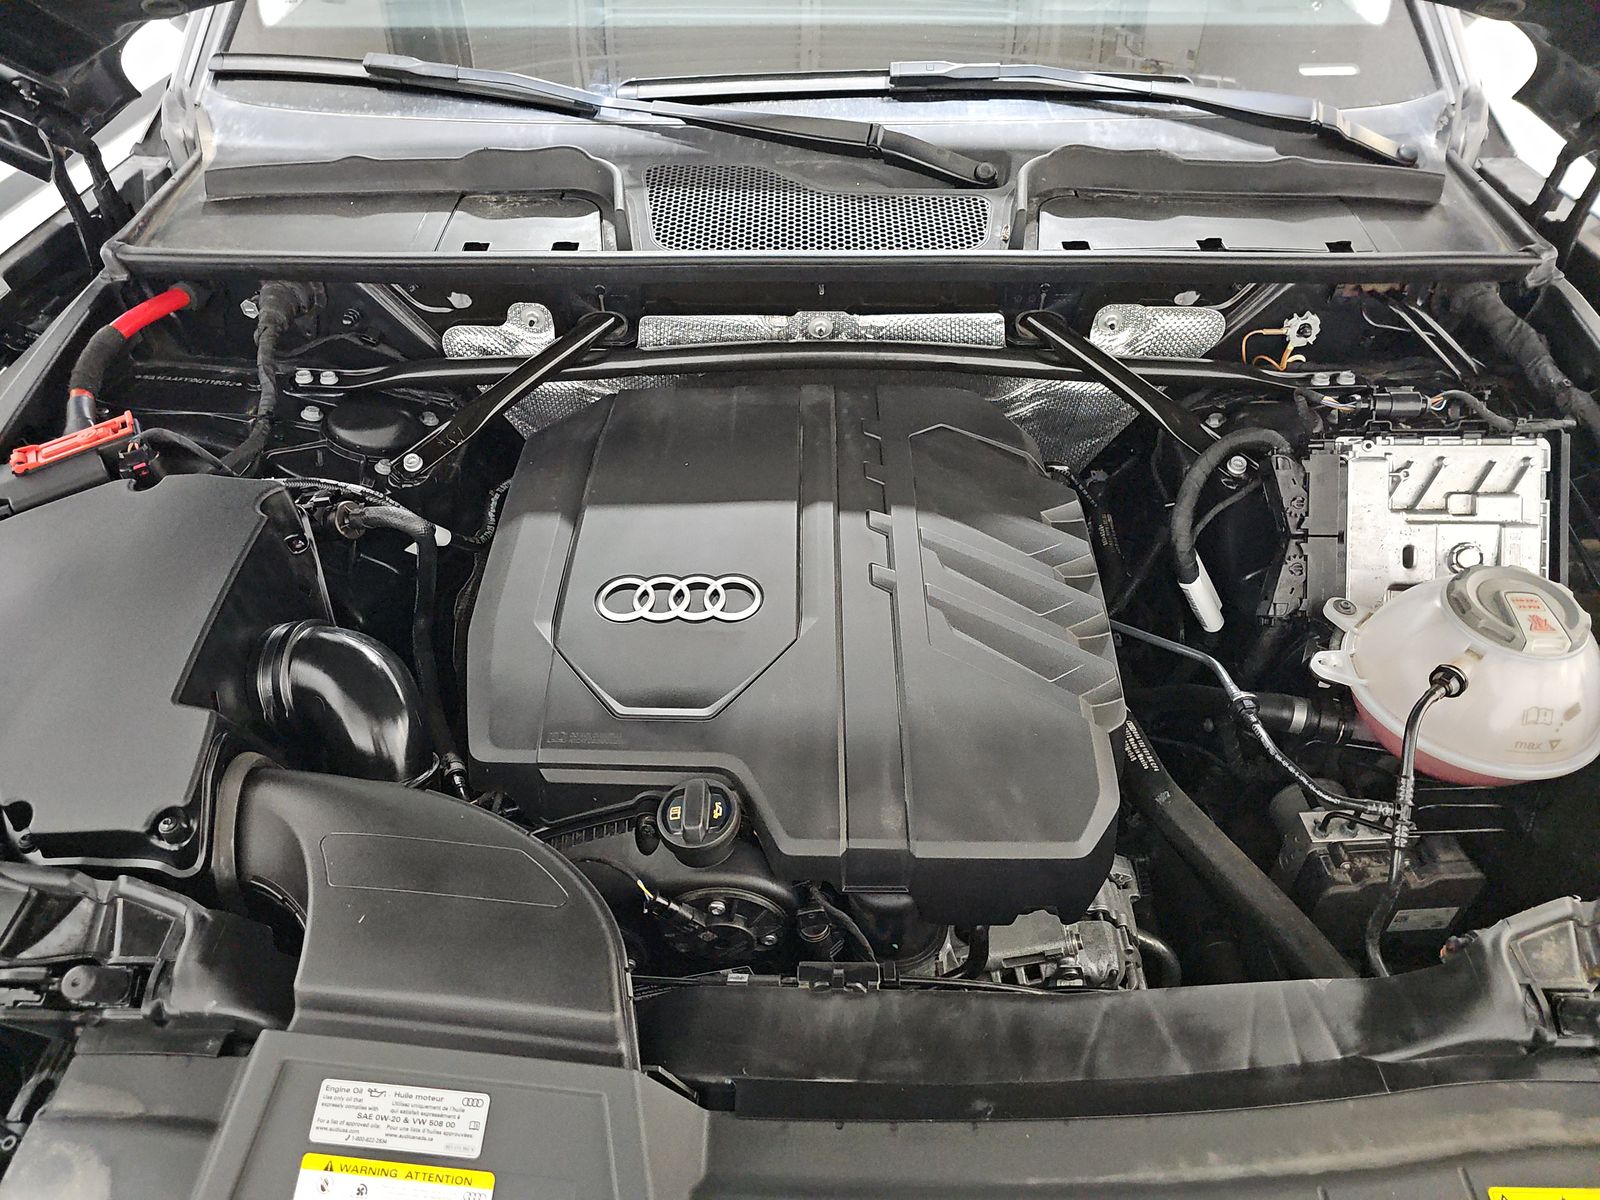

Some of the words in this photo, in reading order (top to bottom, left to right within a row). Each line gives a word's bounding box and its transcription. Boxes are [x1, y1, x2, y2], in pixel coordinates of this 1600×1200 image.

[1514, 740, 1543, 750] max
[325, 1084, 350, 1094] Engine
[353, 1086, 363, 1094] Oil
[394, 1091, 413, 1099] Huile
[415, 1094, 445, 1102] moteur
[357, 1112, 373, 1120] SAE
[375, 1114, 401, 1123] 0W-20
[412, 1118, 427, 1126] VW
[429, 1119, 443, 1127] 508
[339, 1163, 398, 1178] WARNING
[405, 1171, 473, 1186] ATTENTION
